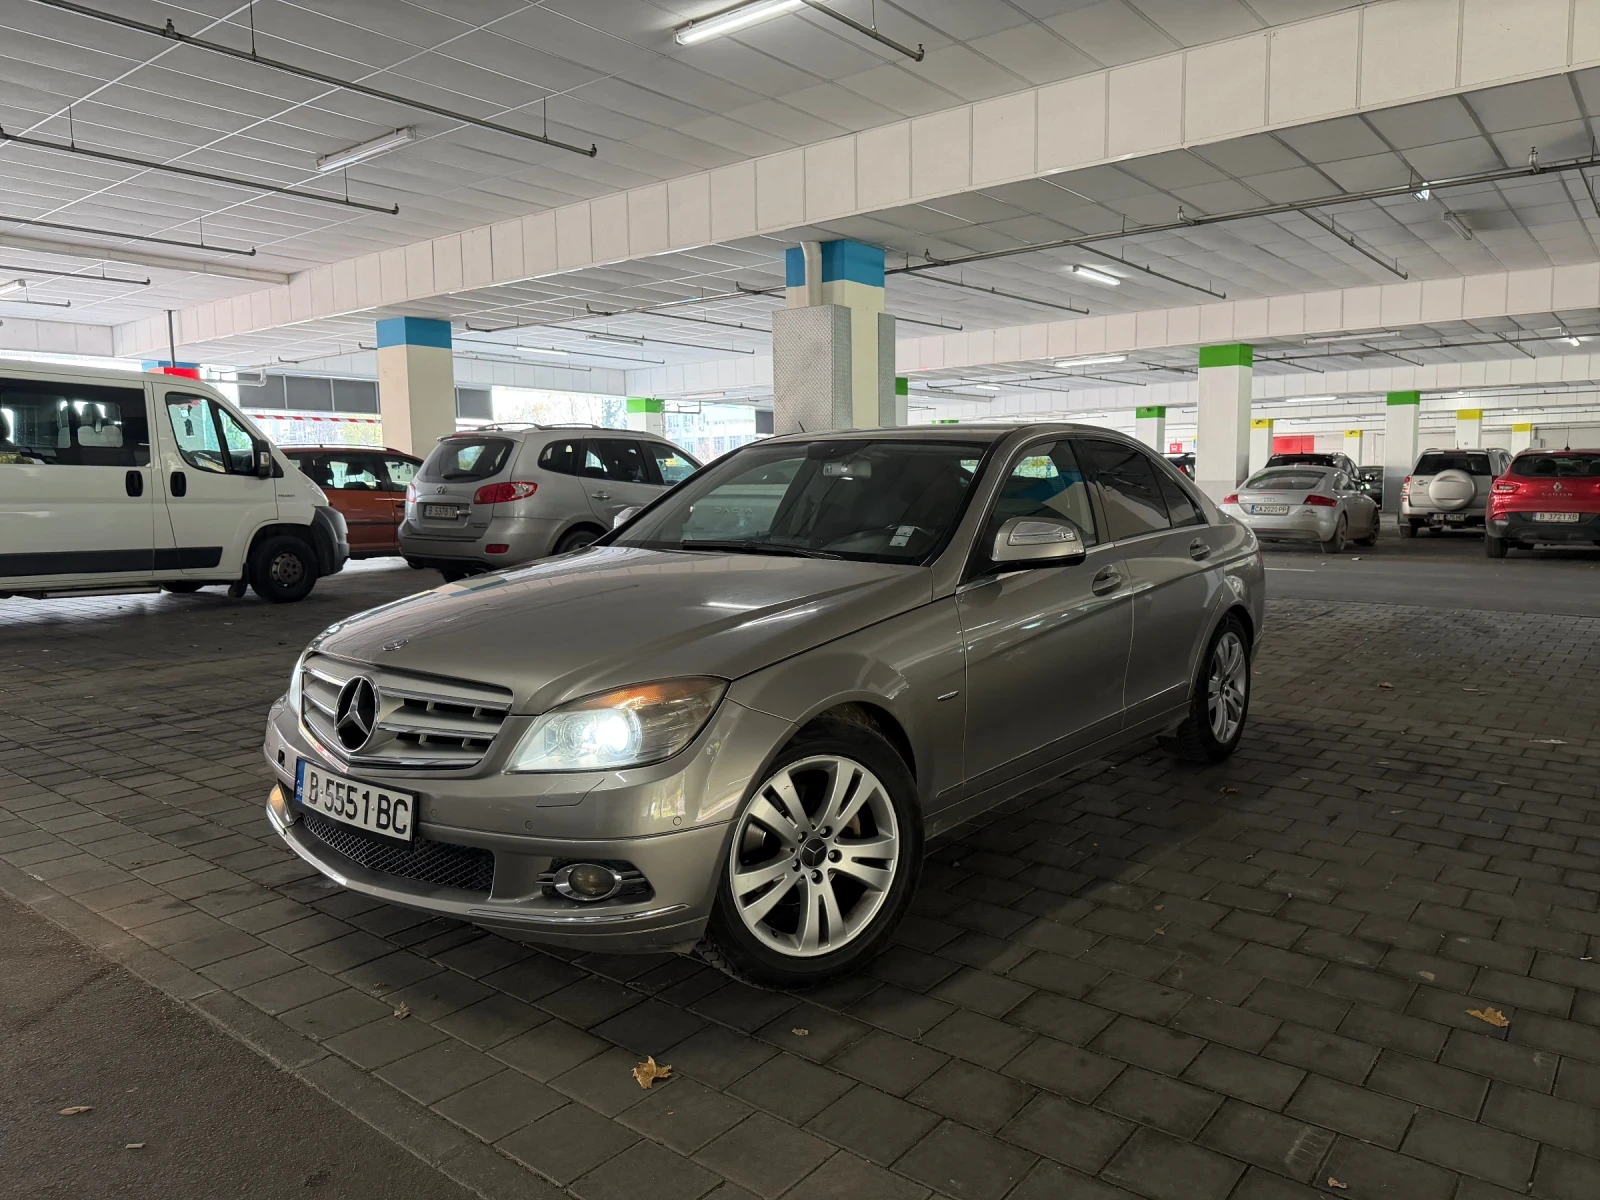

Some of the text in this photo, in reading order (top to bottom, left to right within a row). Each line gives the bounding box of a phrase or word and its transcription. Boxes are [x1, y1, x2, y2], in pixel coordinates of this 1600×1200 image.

[309, 771, 319, 805] B
[324, 779, 370, 825] 5551
[376, 793, 408, 834] BC
